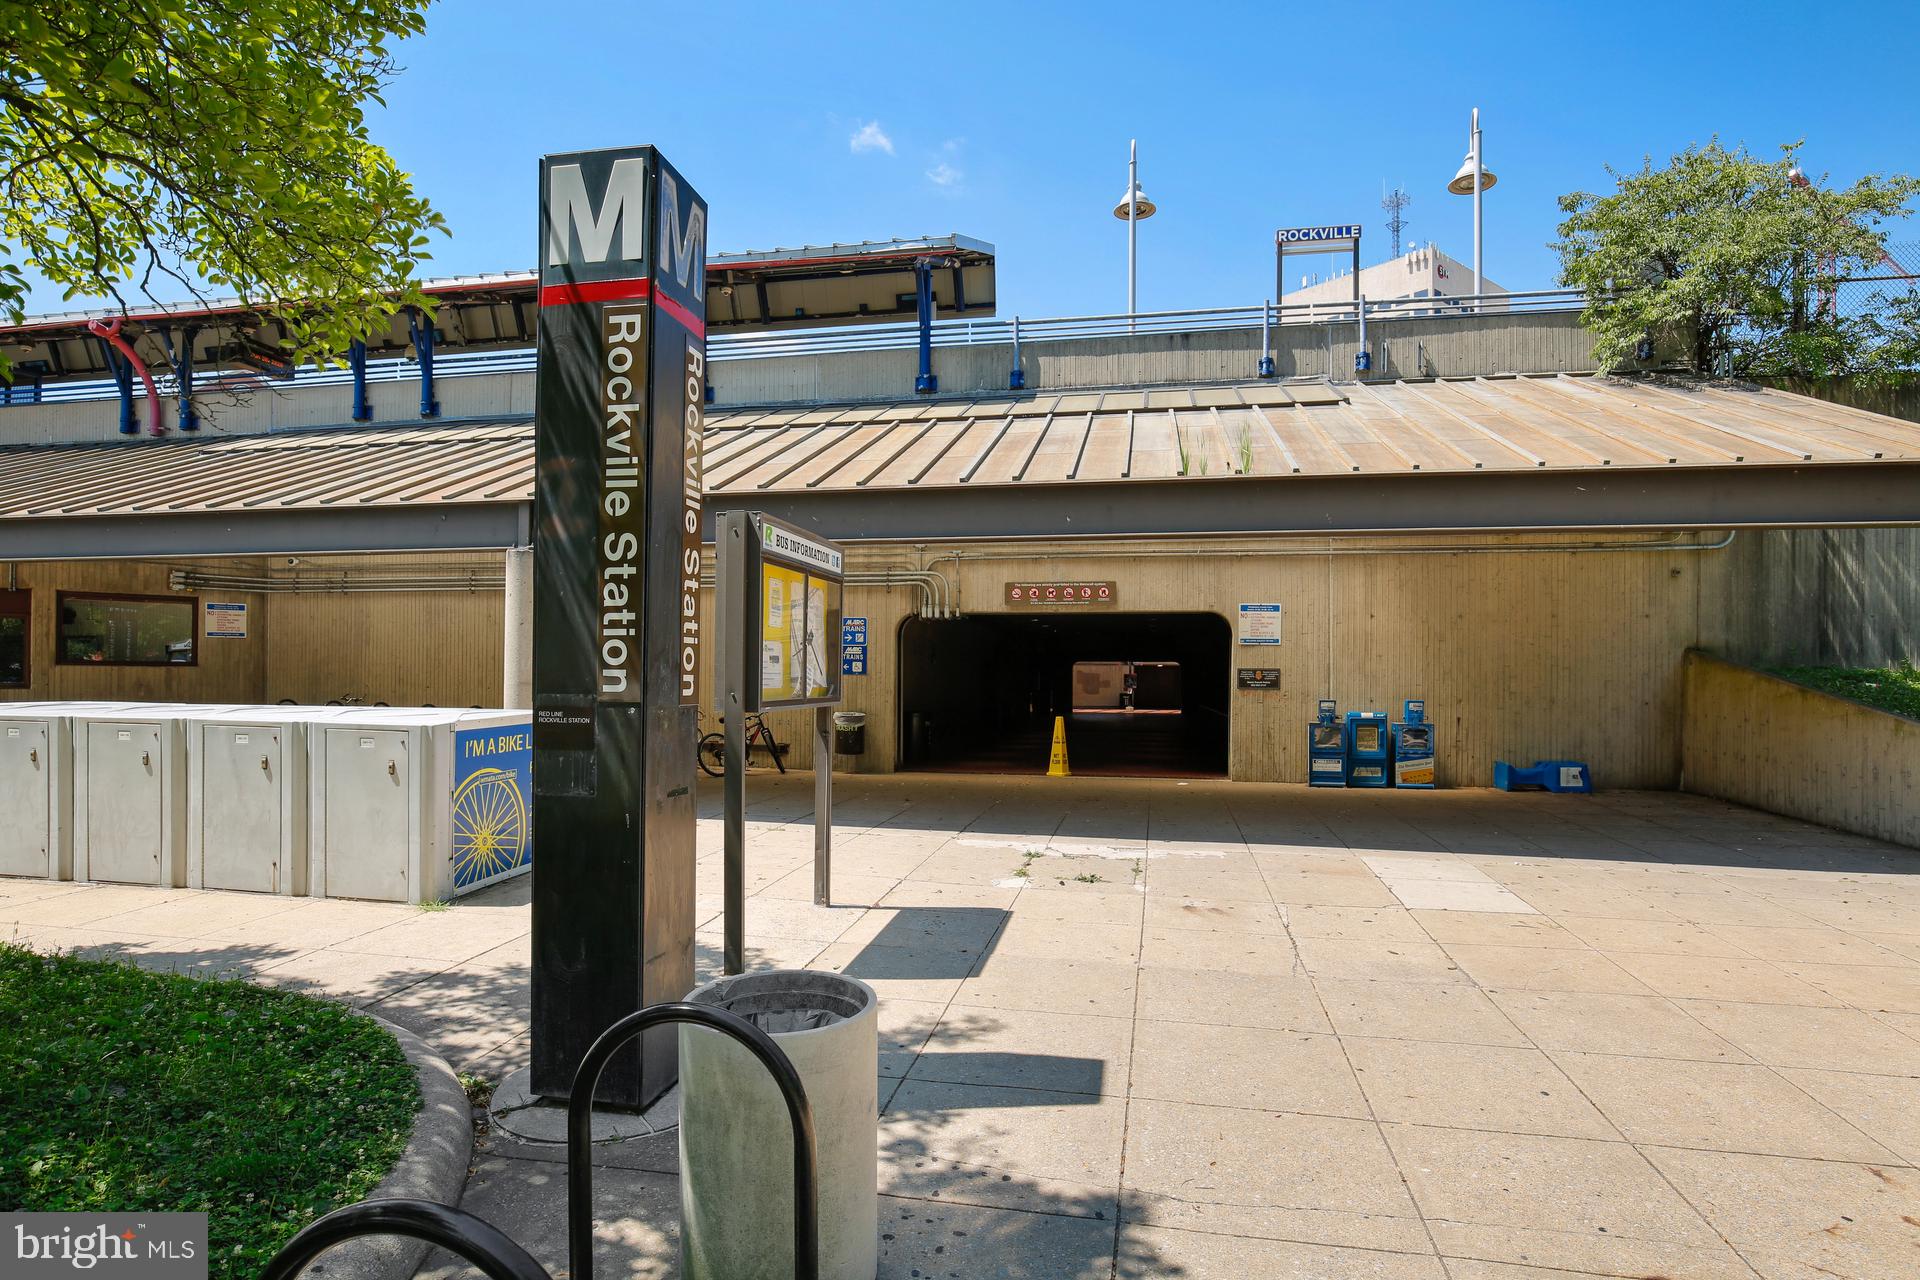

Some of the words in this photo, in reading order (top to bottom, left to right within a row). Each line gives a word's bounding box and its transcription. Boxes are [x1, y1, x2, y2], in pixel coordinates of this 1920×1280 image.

[549, 157, 644, 266] M
[660, 168, 705, 303] M
[1278, 225, 1360, 242] ROCKVILLE
[604, 313, 642, 517] Rockville
[684, 344, 703, 534] Rockville
[602, 531, 638, 693] Station
[775, 534, 789, 550] BUS
[789, 539, 830, 565] INFORMATION
[682, 547, 700, 697] Station
[465, 738, 485, 758] I'M
[486, 737, 496, 755] A
[498, 734, 523, 754] BIKE
